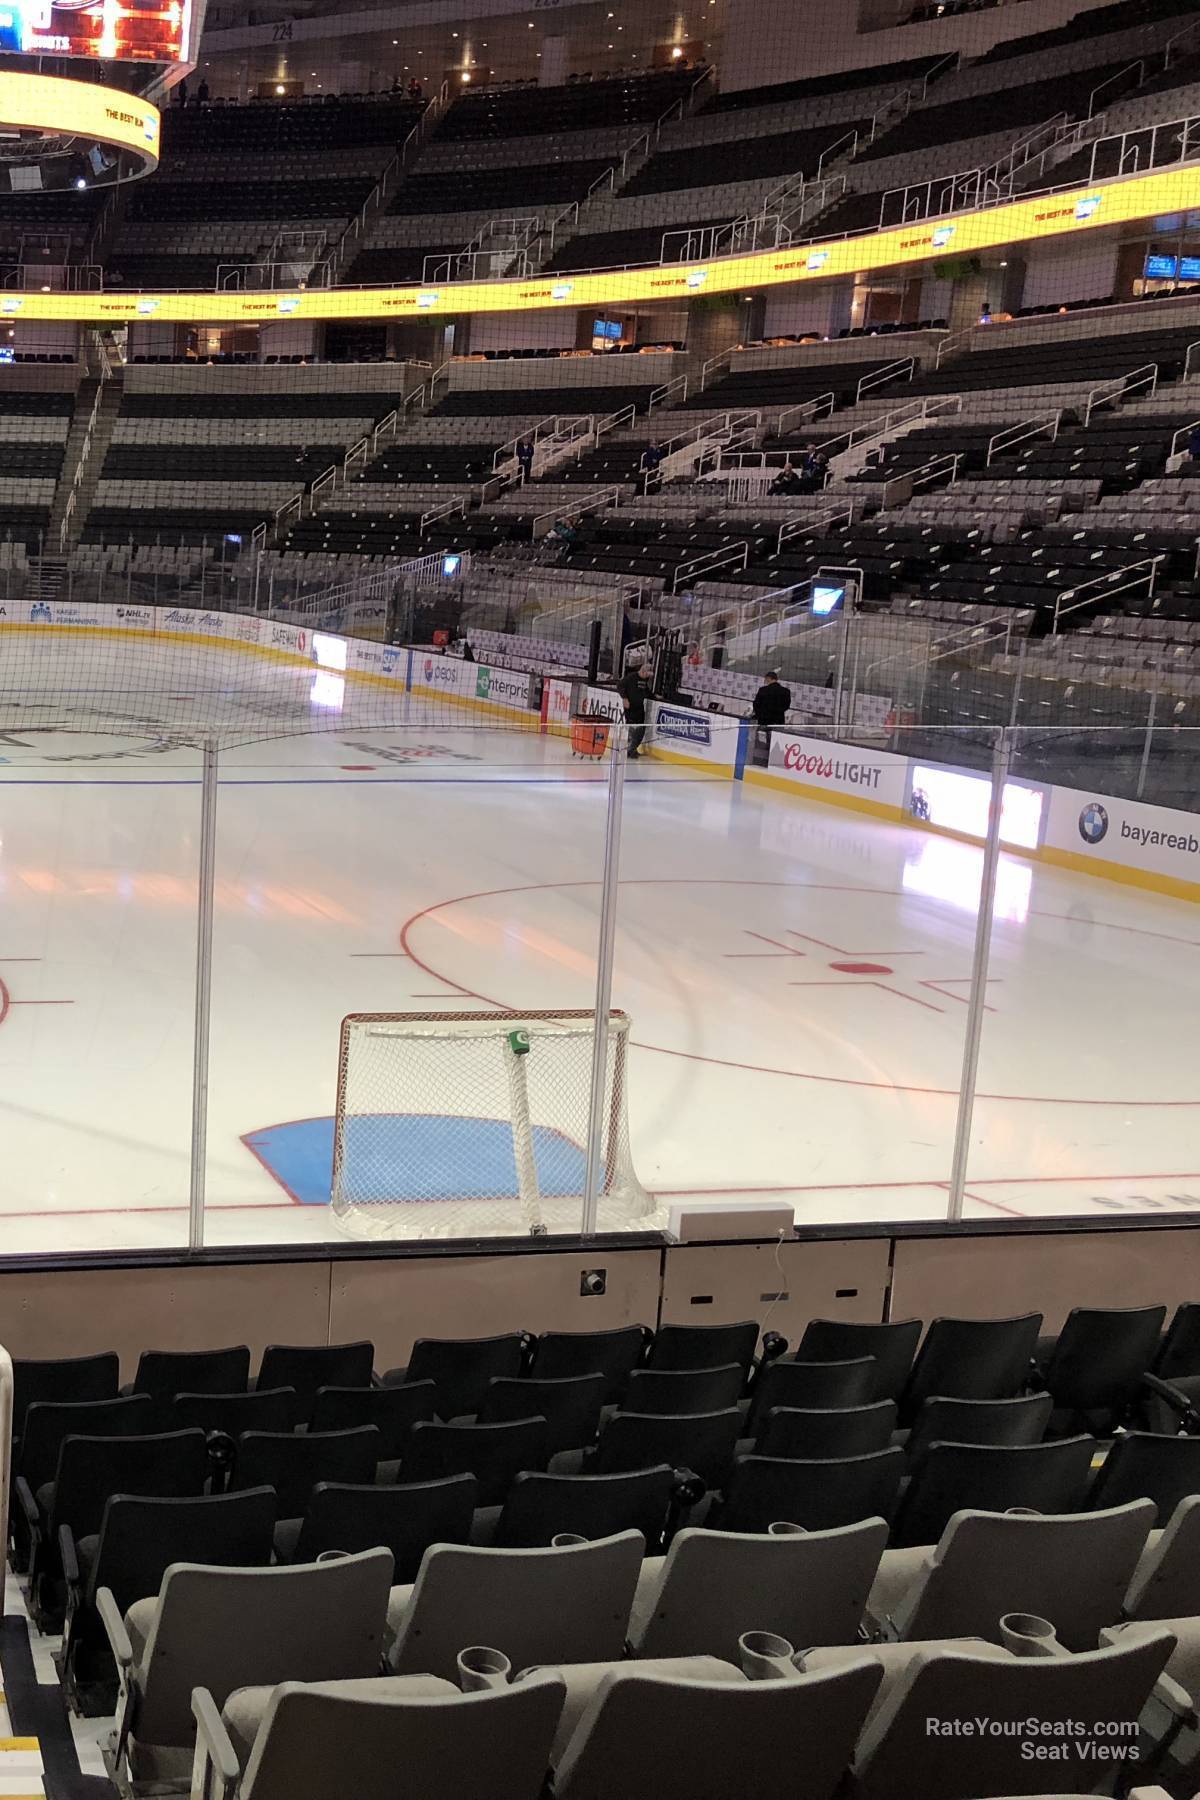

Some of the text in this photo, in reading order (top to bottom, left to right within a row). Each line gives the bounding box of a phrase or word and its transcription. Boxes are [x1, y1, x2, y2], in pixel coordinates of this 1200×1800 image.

[272, 22, 293, 41] 224
[480, 676, 529, 700] enterpris
[589, 698, 626, 724] Metrix
[784, 742, 882, 788] Coors LIGHT
[1120, 820, 1200, 854] bayareab
